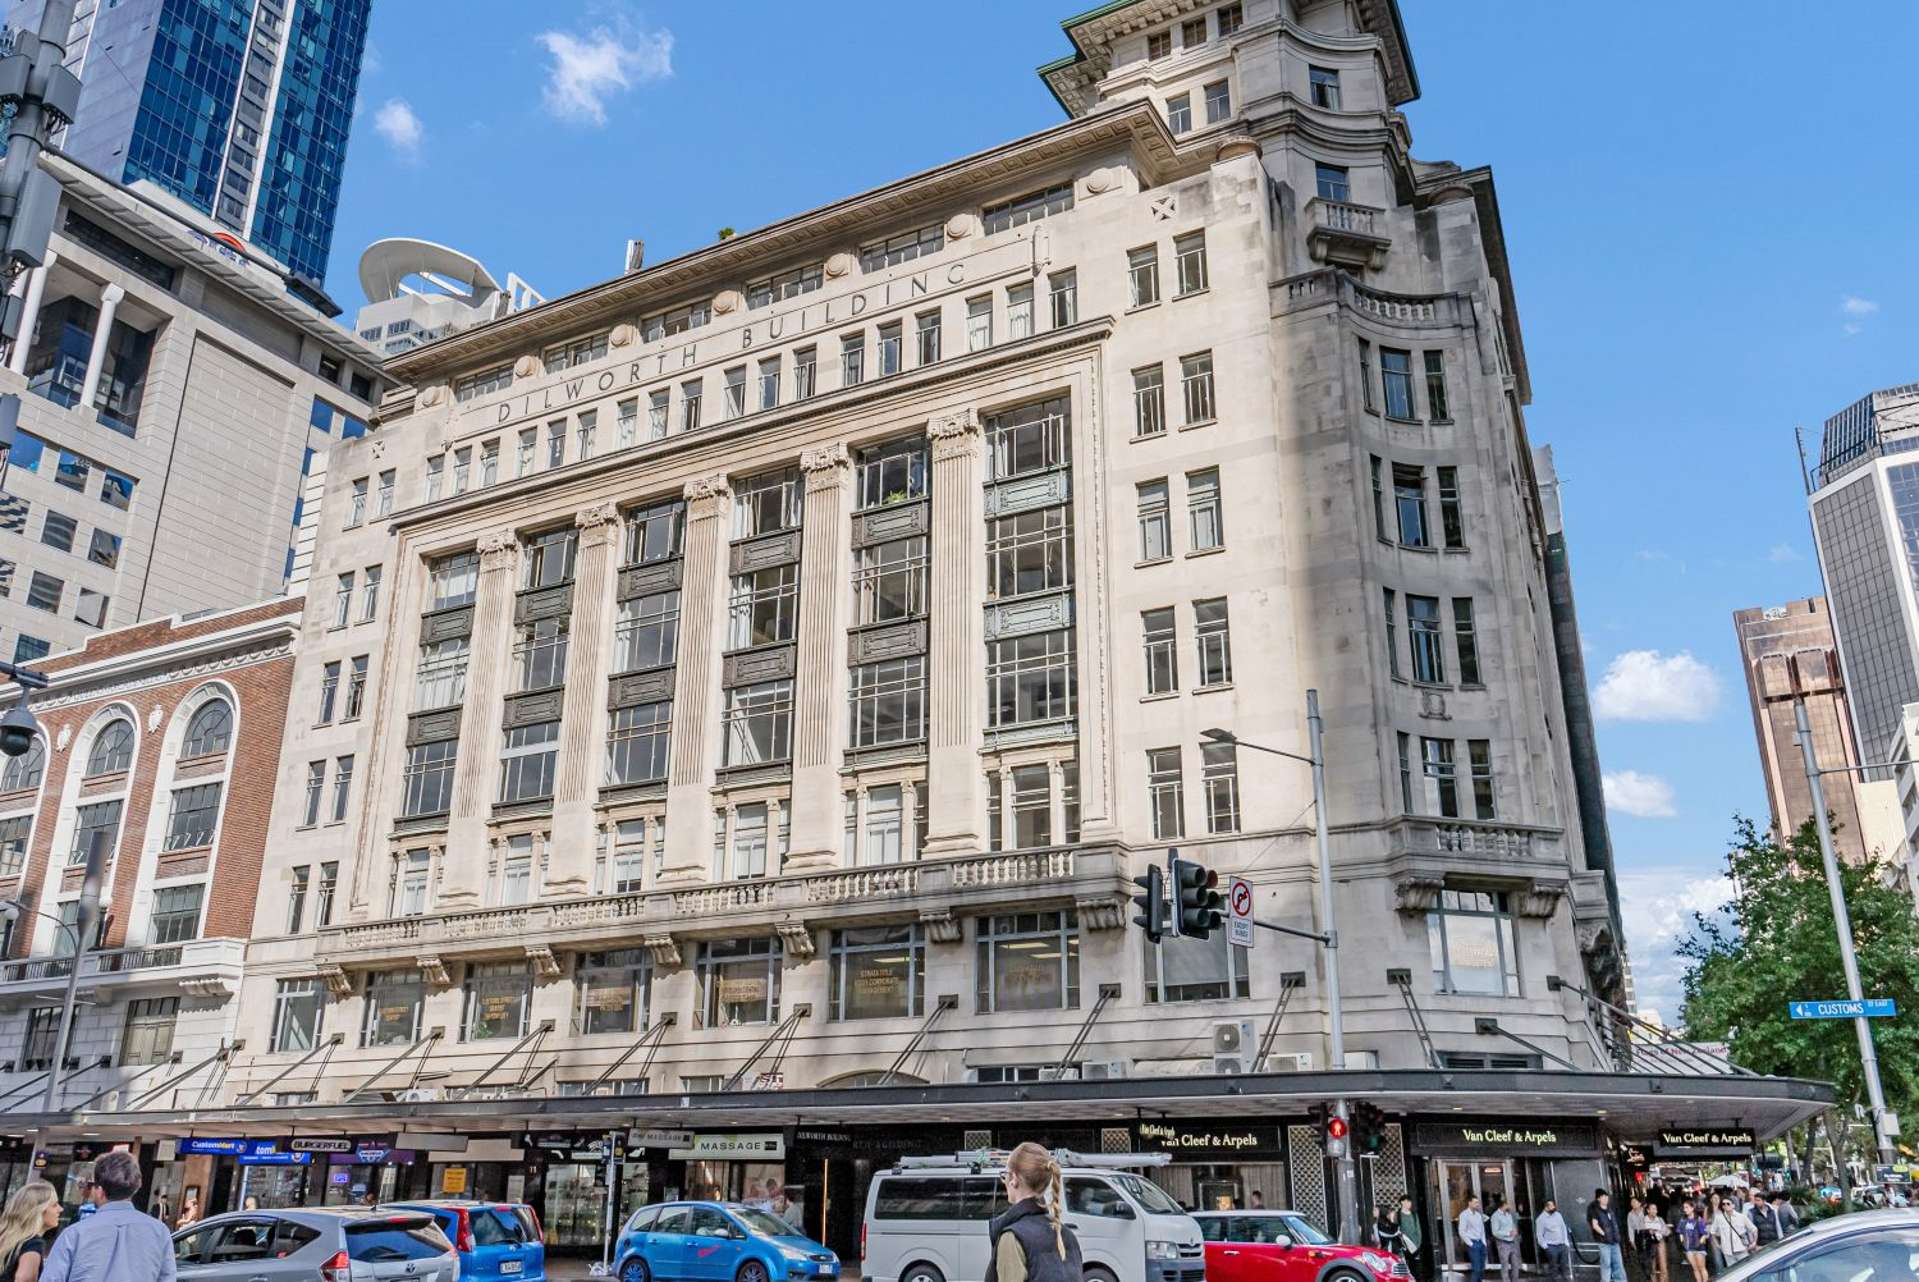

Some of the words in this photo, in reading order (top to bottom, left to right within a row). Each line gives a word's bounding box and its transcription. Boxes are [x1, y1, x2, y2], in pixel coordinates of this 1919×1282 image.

[498, 343, 697, 423] DILWORTH
[742, 264, 965, 350] BUILDING
[1817, 1002, 1865, 1016] CUSTOMS
[1181, 1134, 1211, 1146] Cleef
[1212, 1136, 1221, 1146] &
[1222, 1133, 1258, 1149] Arpels
[1462, 1128, 1483, 1142] Van
[1485, 1129, 1513, 1142] Cleef
[1515, 1132, 1523, 1142] &
[1525, 1130, 1557, 1146] Arpels
[1662, 1132, 1682, 1143] Van
[1683, 1132, 1710, 1143] Cleef
[1711, 1134, 1719, 1143] &
[1721, 1132, 1752, 1146] Arpels
[700, 1142, 761, 1151] MASSAGE
